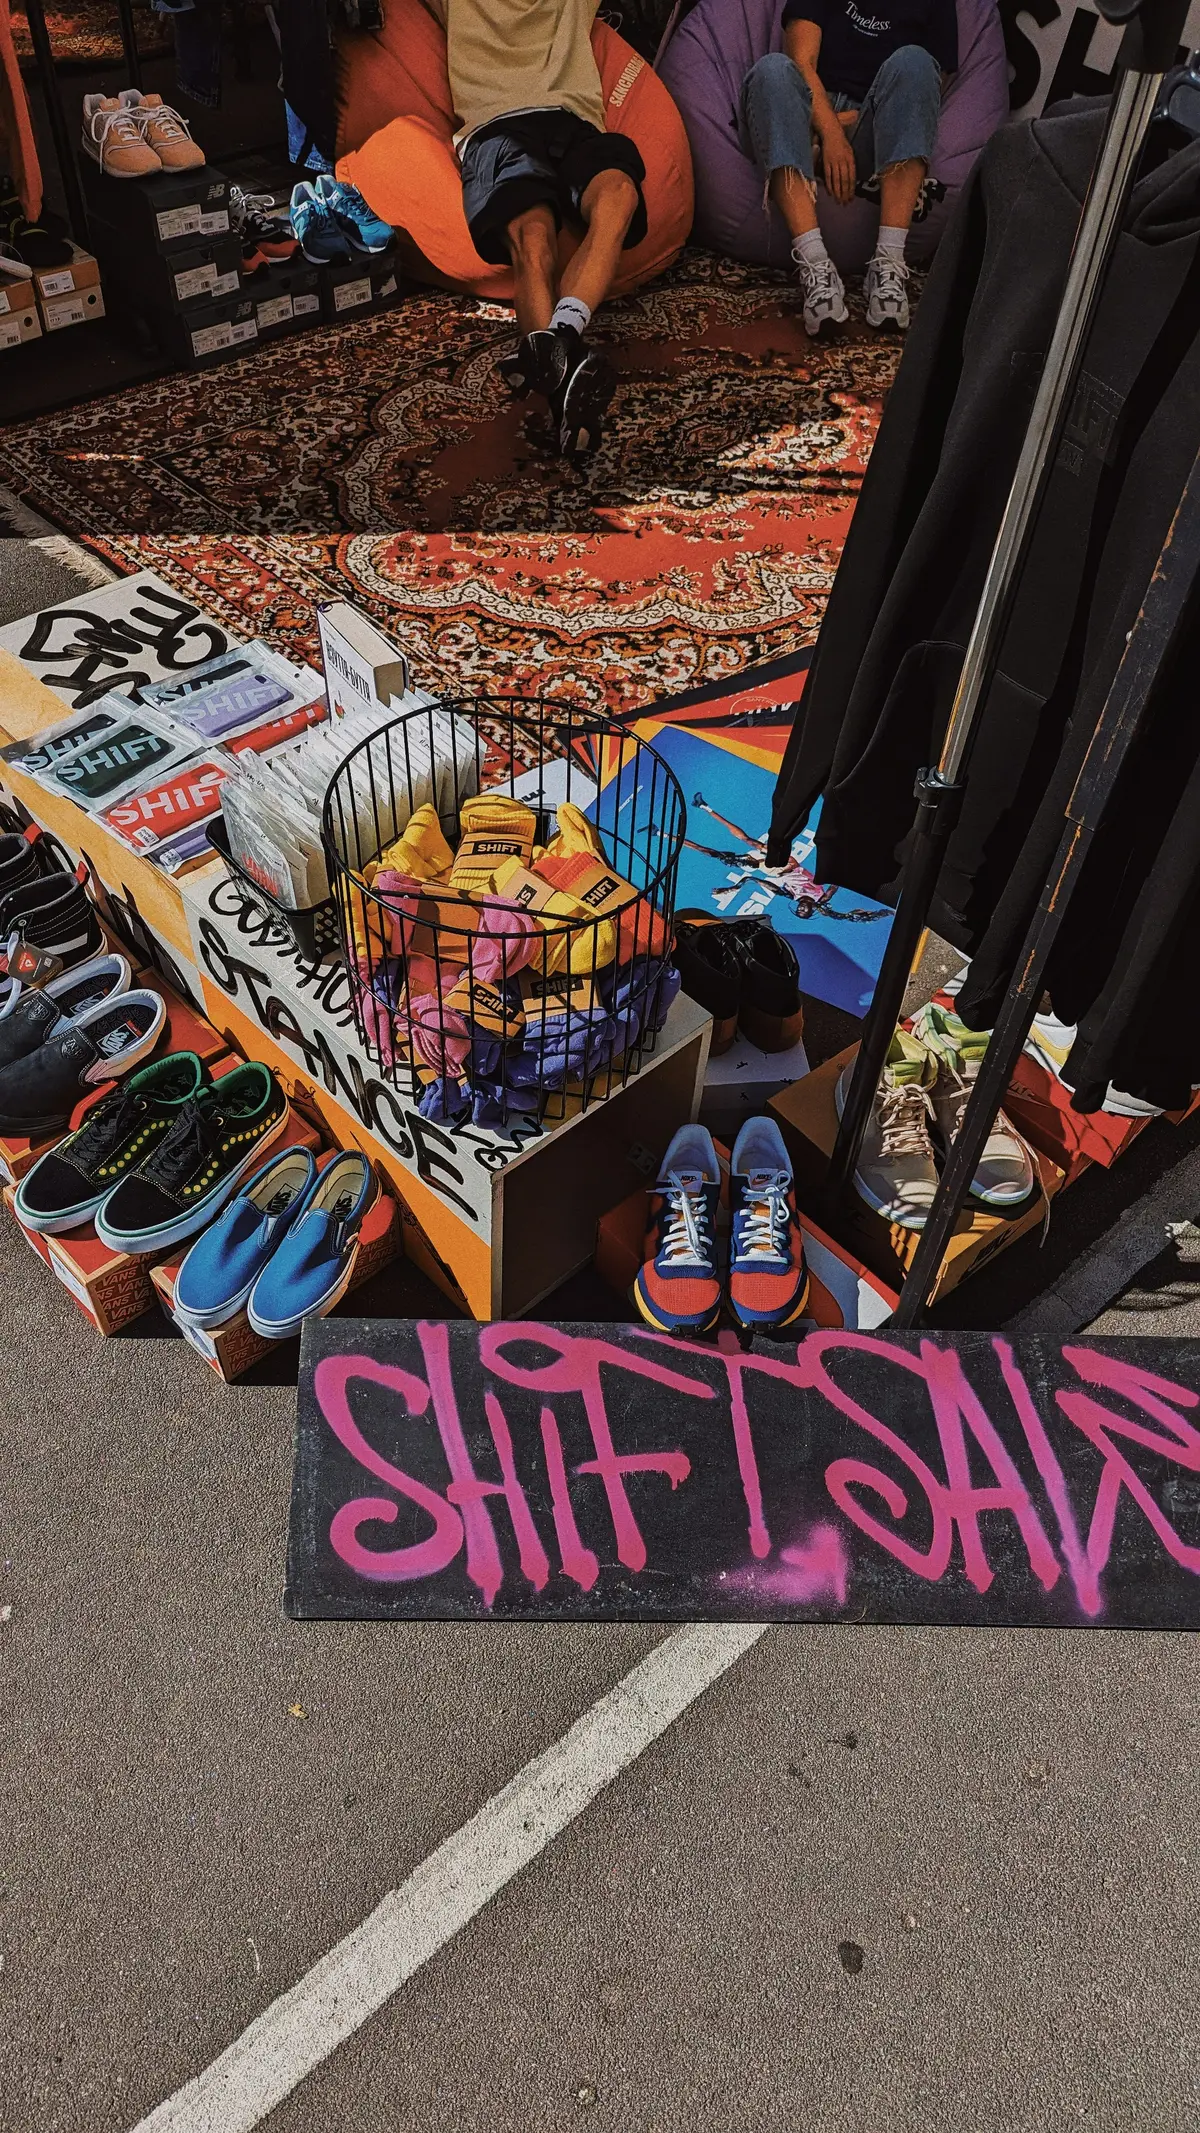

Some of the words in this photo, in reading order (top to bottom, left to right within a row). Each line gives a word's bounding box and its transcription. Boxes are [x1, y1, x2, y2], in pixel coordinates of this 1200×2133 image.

[180, 683, 283, 721] SHIFT
[57, 734, 162, 782] SHIFT
[109, 778, 226, 826] SHIF
[477, 842, 517, 853] SHIFT
[198, 916, 479, 1222] STANCE
[102, 1266, 138, 1286] VANS
[101, 1295, 131, 1310] ANS
[110, 1301, 146, 1320] VANS
[314, 1322, 806, 1609] SHIFT
